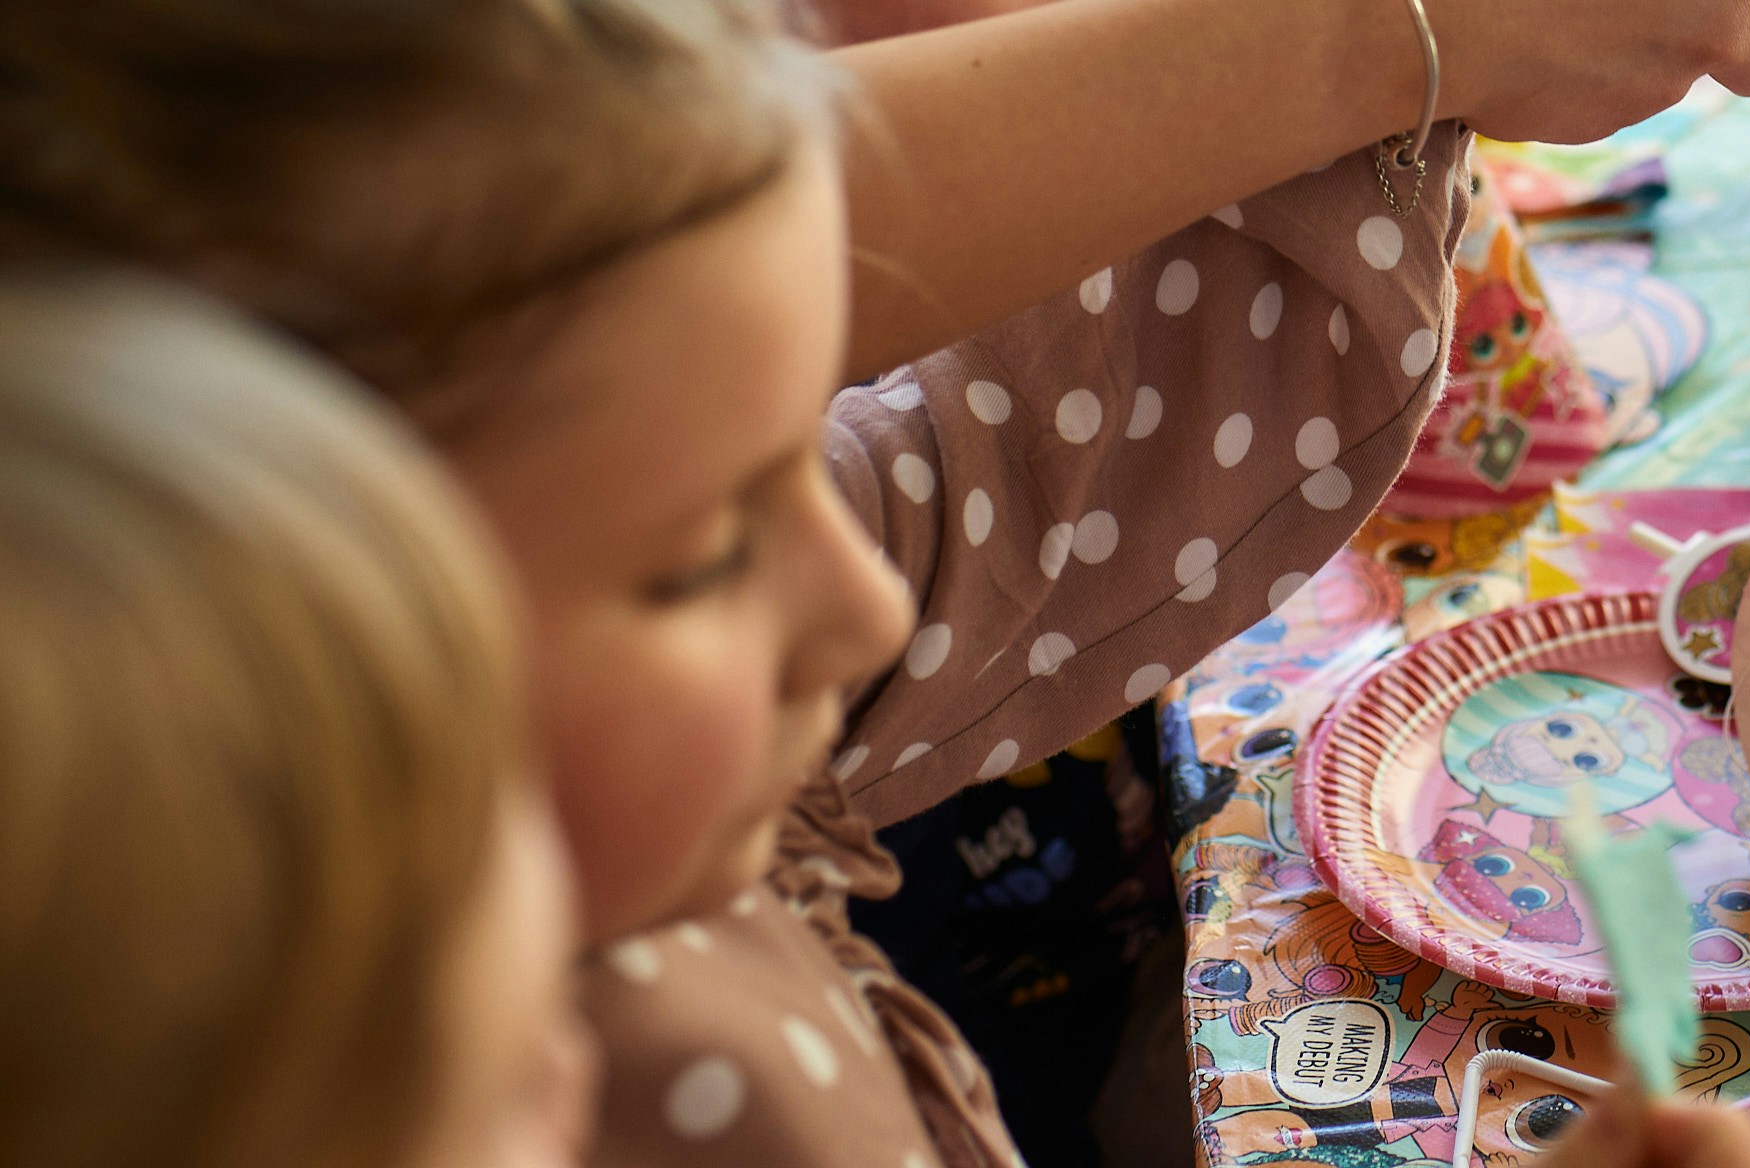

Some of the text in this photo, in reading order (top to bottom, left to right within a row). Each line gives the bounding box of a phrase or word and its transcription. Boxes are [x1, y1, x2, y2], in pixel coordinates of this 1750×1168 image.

[1293, 1014, 1336, 1088] MY DEBUT
[1332, 1023, 1376, 1084] MAKING
